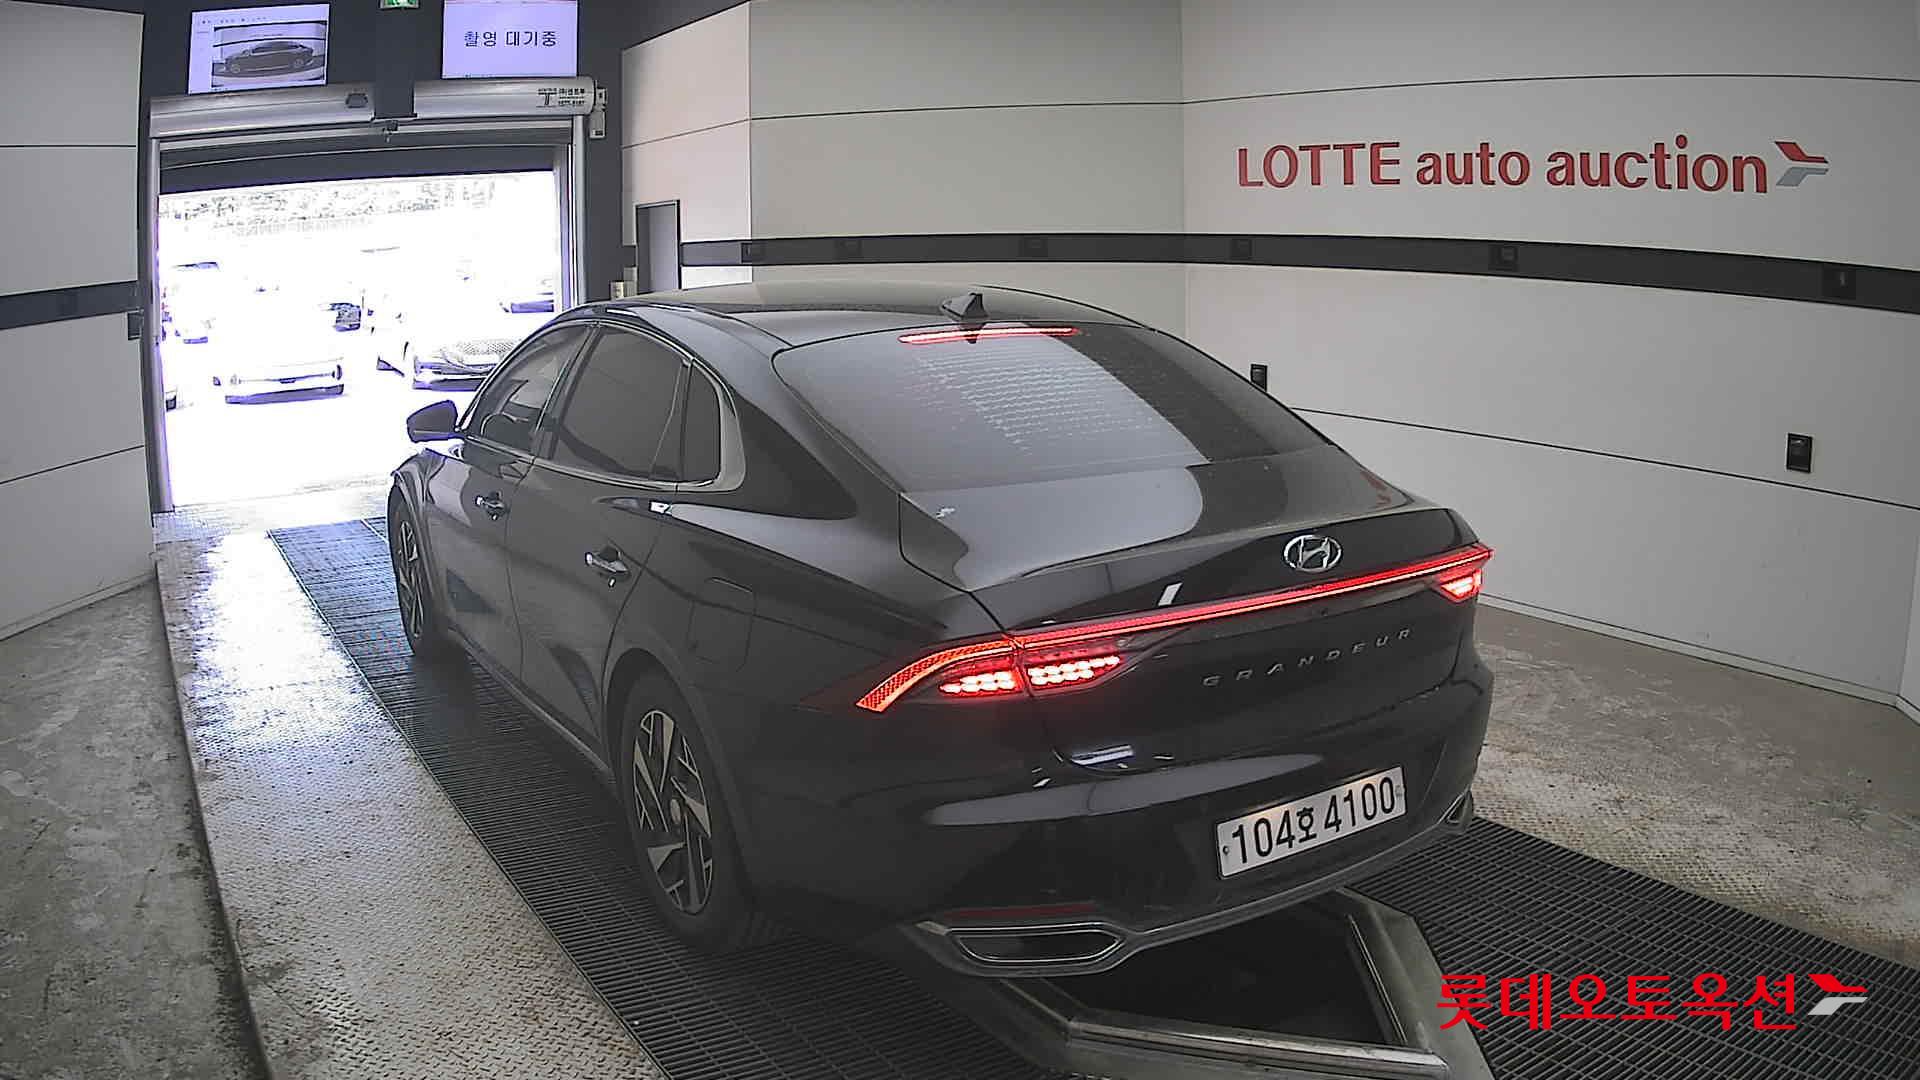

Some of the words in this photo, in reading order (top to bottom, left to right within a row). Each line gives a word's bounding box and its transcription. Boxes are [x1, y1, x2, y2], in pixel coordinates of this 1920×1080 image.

[463, 31, 497, 47] 촬영
[505, 31, 557, 47] 대기중
[1237, 141, 1401, 188] LOTTE
[1415, 142, 1531, 186] auto
[1546, 134, 1768, 194] auction
[1202, 628, 1410, 687] GRANDEUR
